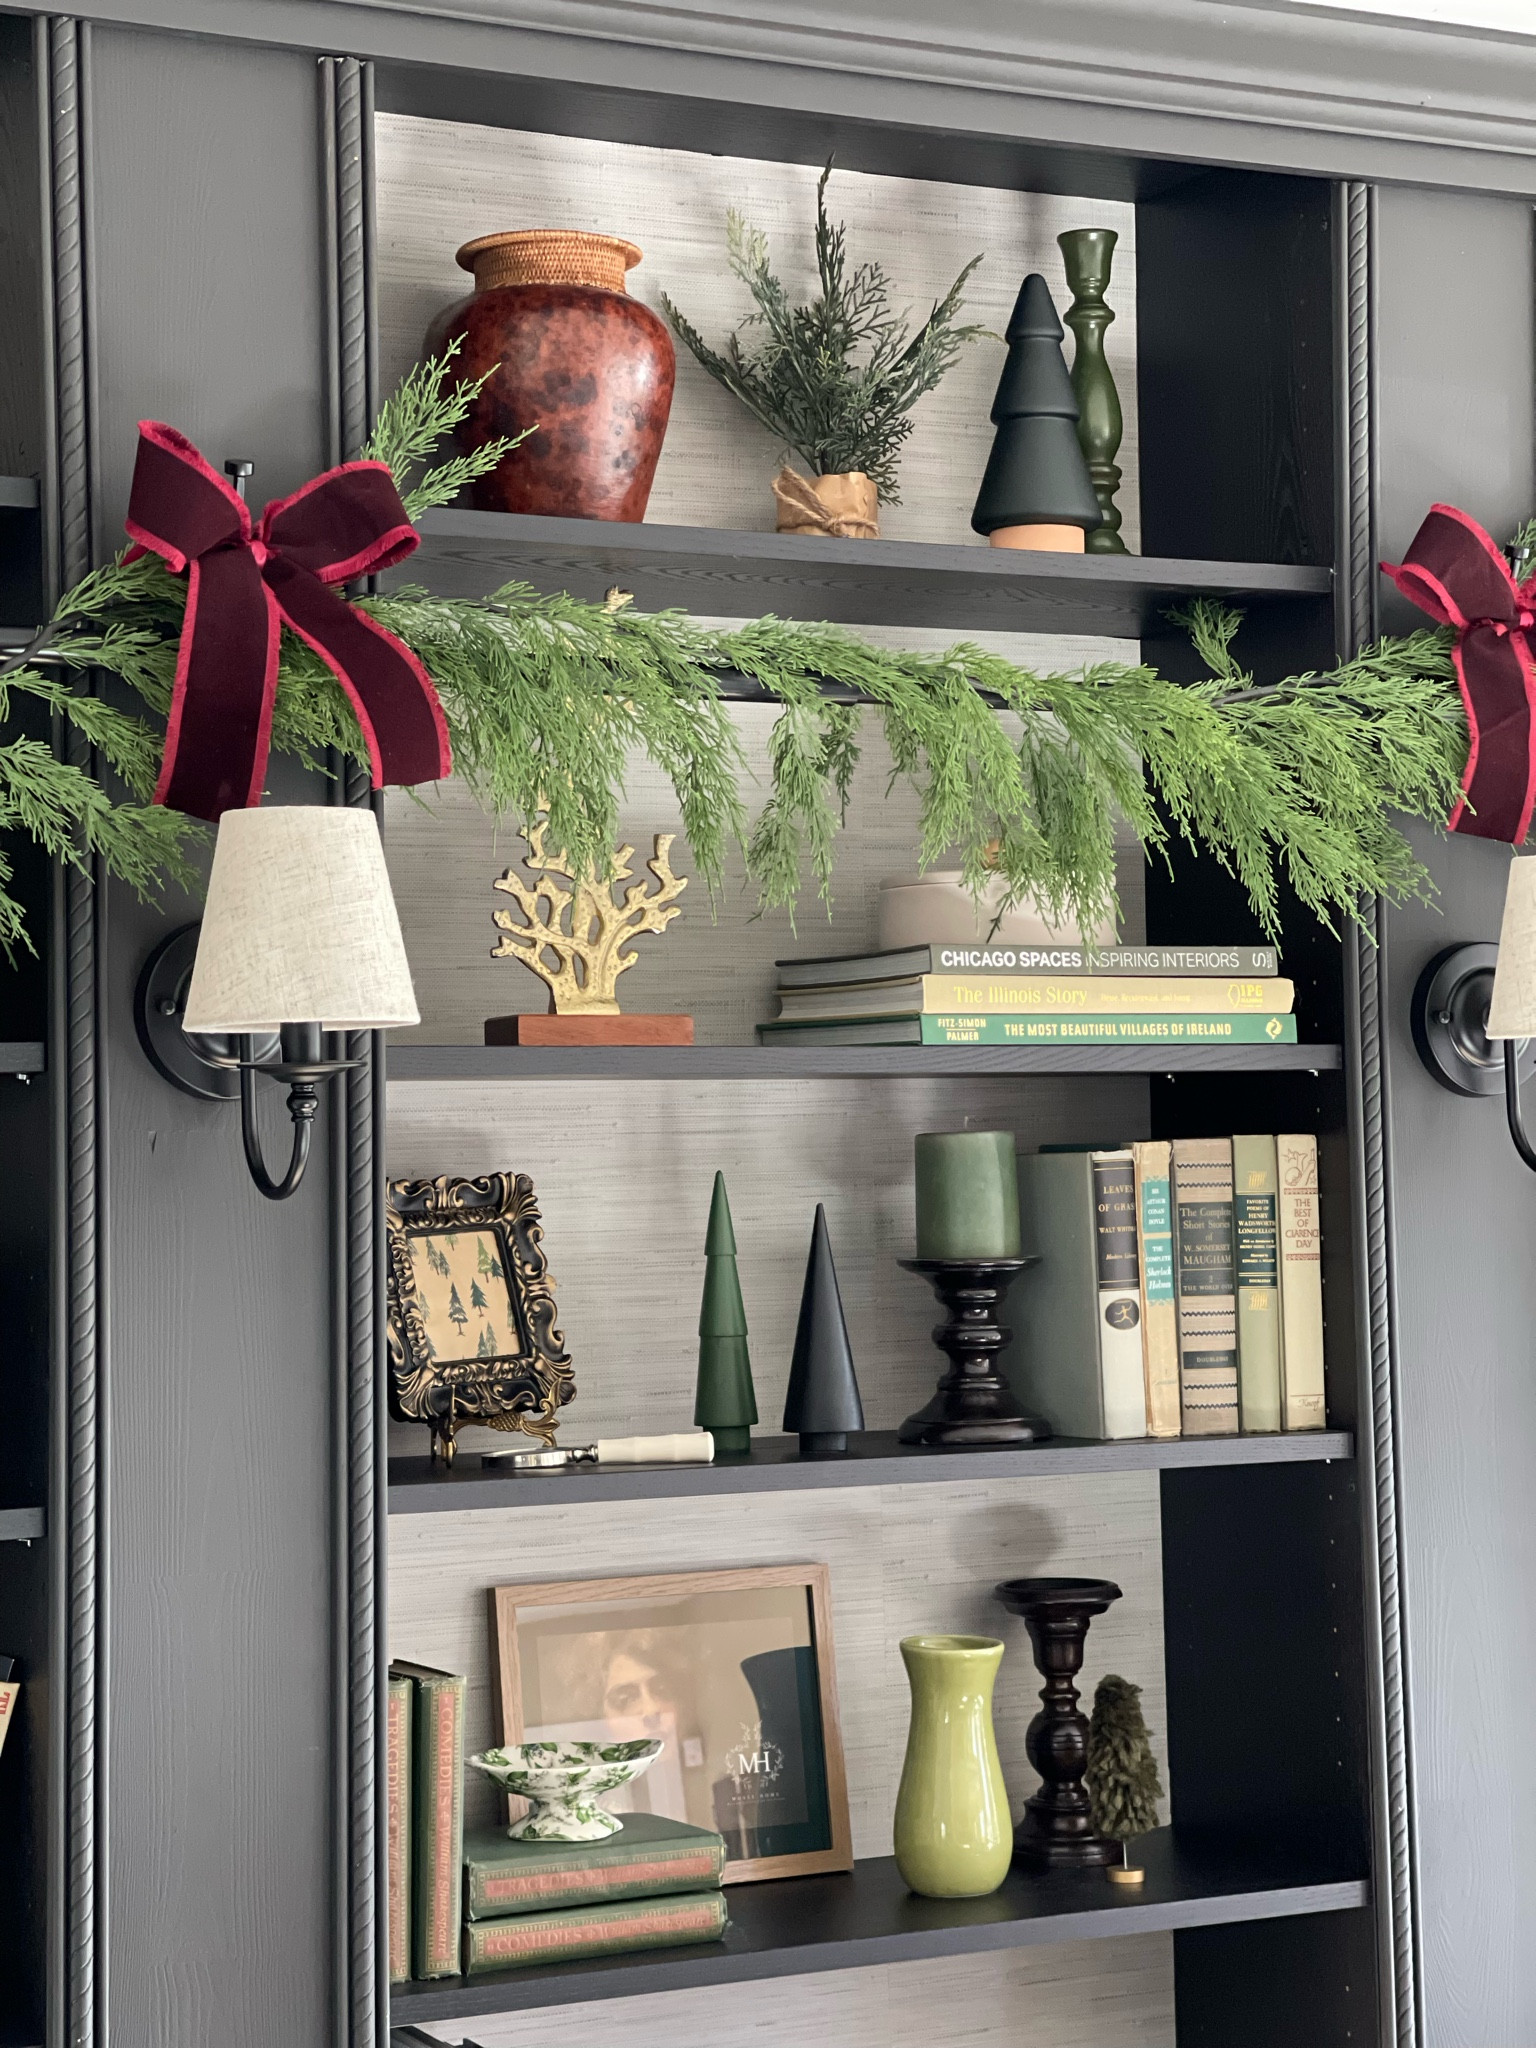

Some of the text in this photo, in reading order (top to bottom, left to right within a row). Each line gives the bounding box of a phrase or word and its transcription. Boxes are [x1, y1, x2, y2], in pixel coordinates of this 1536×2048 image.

[940, 951, 1240, 968] CHICAGO SPACES INSPIRING INTERIORS
[953, 986, 983, 1003] The
[989, 986, 1041, 1003] Illinois
[1046, 985, 1088, 1006] Story
[937, 1018, 987, 1027] FITZ-SIMON
[1004, 1024, 1232, 1036] THE MOST BEAUTIFUL VILLAGES OF IRELAND
[946, 1031, 979, 1041] PALMER
[1103, 1185, 1134, 1194] LEAVES
[1098, 1202, 1135, 1213] OF GRAS
[1294, 1198, 1311, 1207] THE
[1180, 1208, 1197, 1217] The
[1294, 1208, 1312, 1218] BEST
[1183, 1220, 1230, 1230] Short Stories
[1296, 1218, 1309, 1228] OF
[1205, 1232, 1214, 1241] of
[1196, 1243, 1230, 1252] SOMERSET
[1295, 1239, 1312, 1248] DAY
[1183, 1255, 1232, 1265] MAUGHAM
[1146, 1265, 1172, 1277] Sherlock
[1148, 1279, 1171, 1290] Holmes
[439, 1707, 453, 1807] COMEDIES
[738, 1751, 771, 1775] MH
[438, 1825, 451, 1877] William
[497, 1871, 585, 1894] TRAGEDIES
[437, 1879, 450, 1955] Shakespeare
[497, 1931, 581, 1951] COMEDIES
